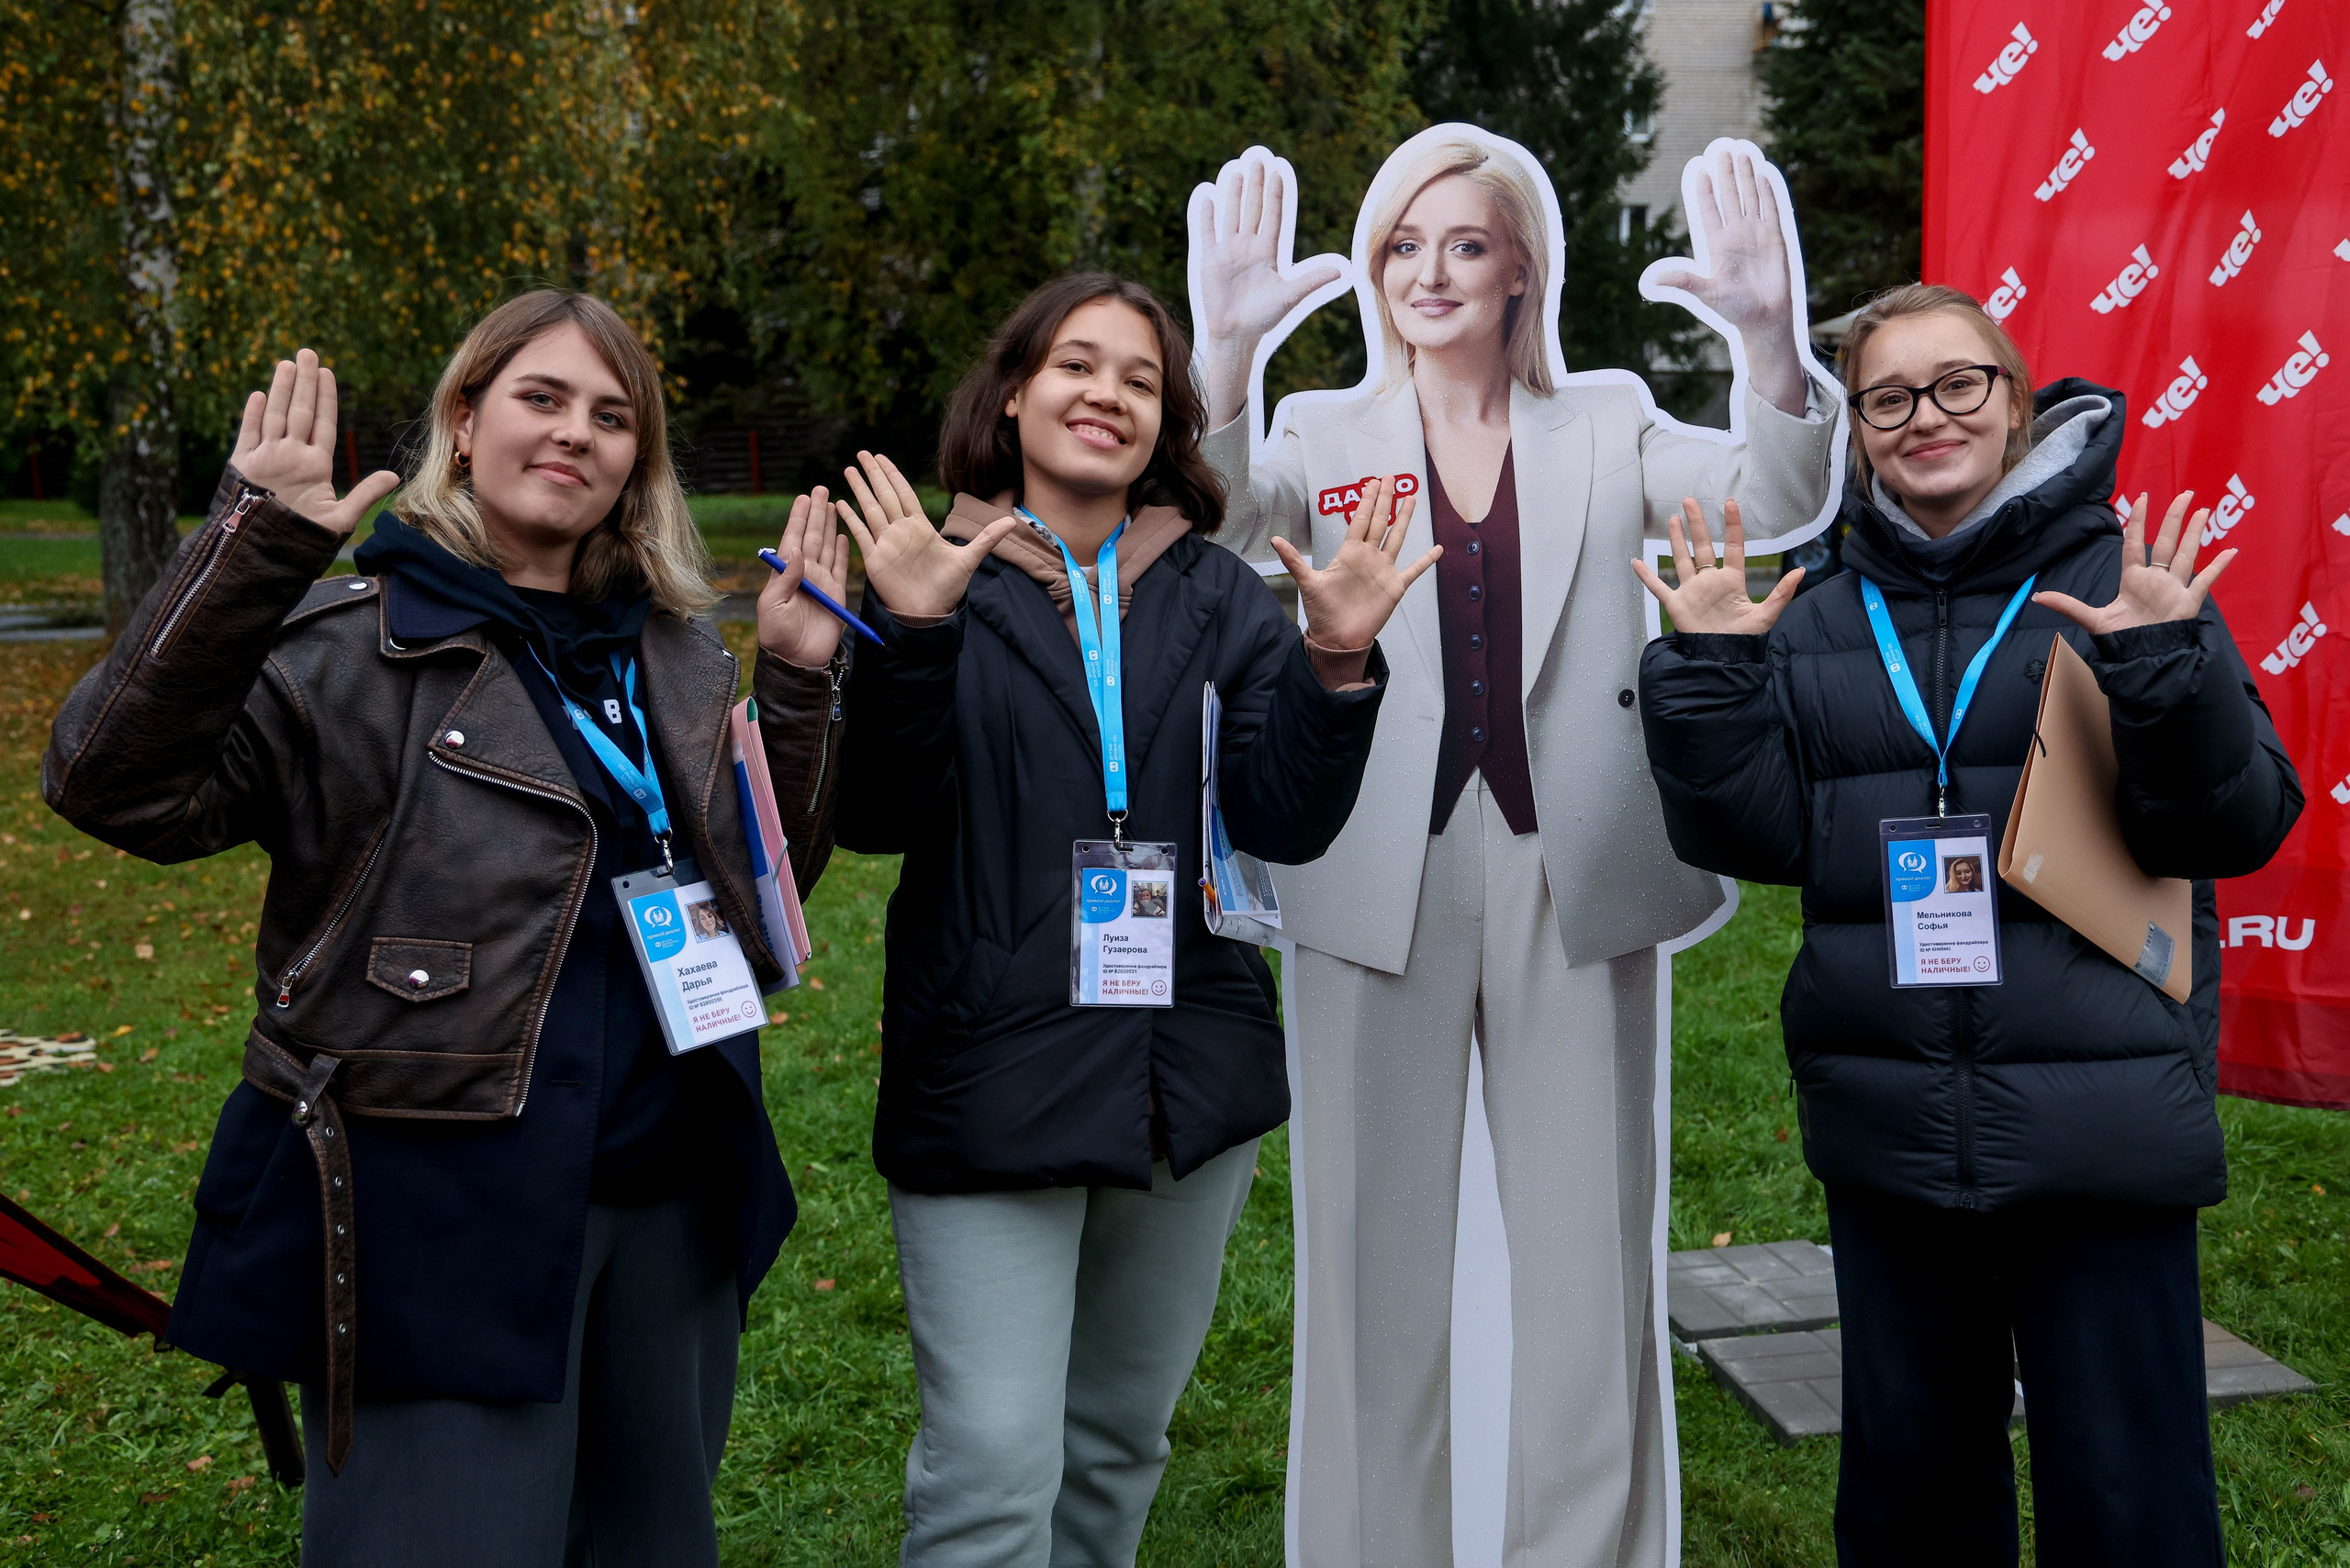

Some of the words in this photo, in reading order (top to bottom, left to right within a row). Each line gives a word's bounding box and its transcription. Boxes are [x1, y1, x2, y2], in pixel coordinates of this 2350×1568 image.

[1972, 21, 2038, 94] че!
[2267, 59, 2333, 138] че!
[2034, 127, 2096, 202] че!
[2209, 209, 2262, 287] че!
[1982, 265, 2027, 325] е!
[2090, 243, 2159, 315] че!
[2255, 330, 2330, 406] че!
[2142, 355, 2208, 429] че!
[1323, 477, 1415, 511] ДАО
[2260, 601, 2327, 676] че!
[1918, 911, 1972, 919] Мельникова
[1918, 923, 1948, 931] Софья
[1103, 935, 1129, 943] Луиза
[1103, 946, 1147, 954] Гузаерова
[677, 960, 718, 977] Хахаева
[682, 977, 712, 992] Дарья
[696, 1014, 741, 1033] НАЛИЧНЫЕ!
[699, 1014, 711, 1022] НЕ
[711, 1007, 730, 1017] БЕРУ
